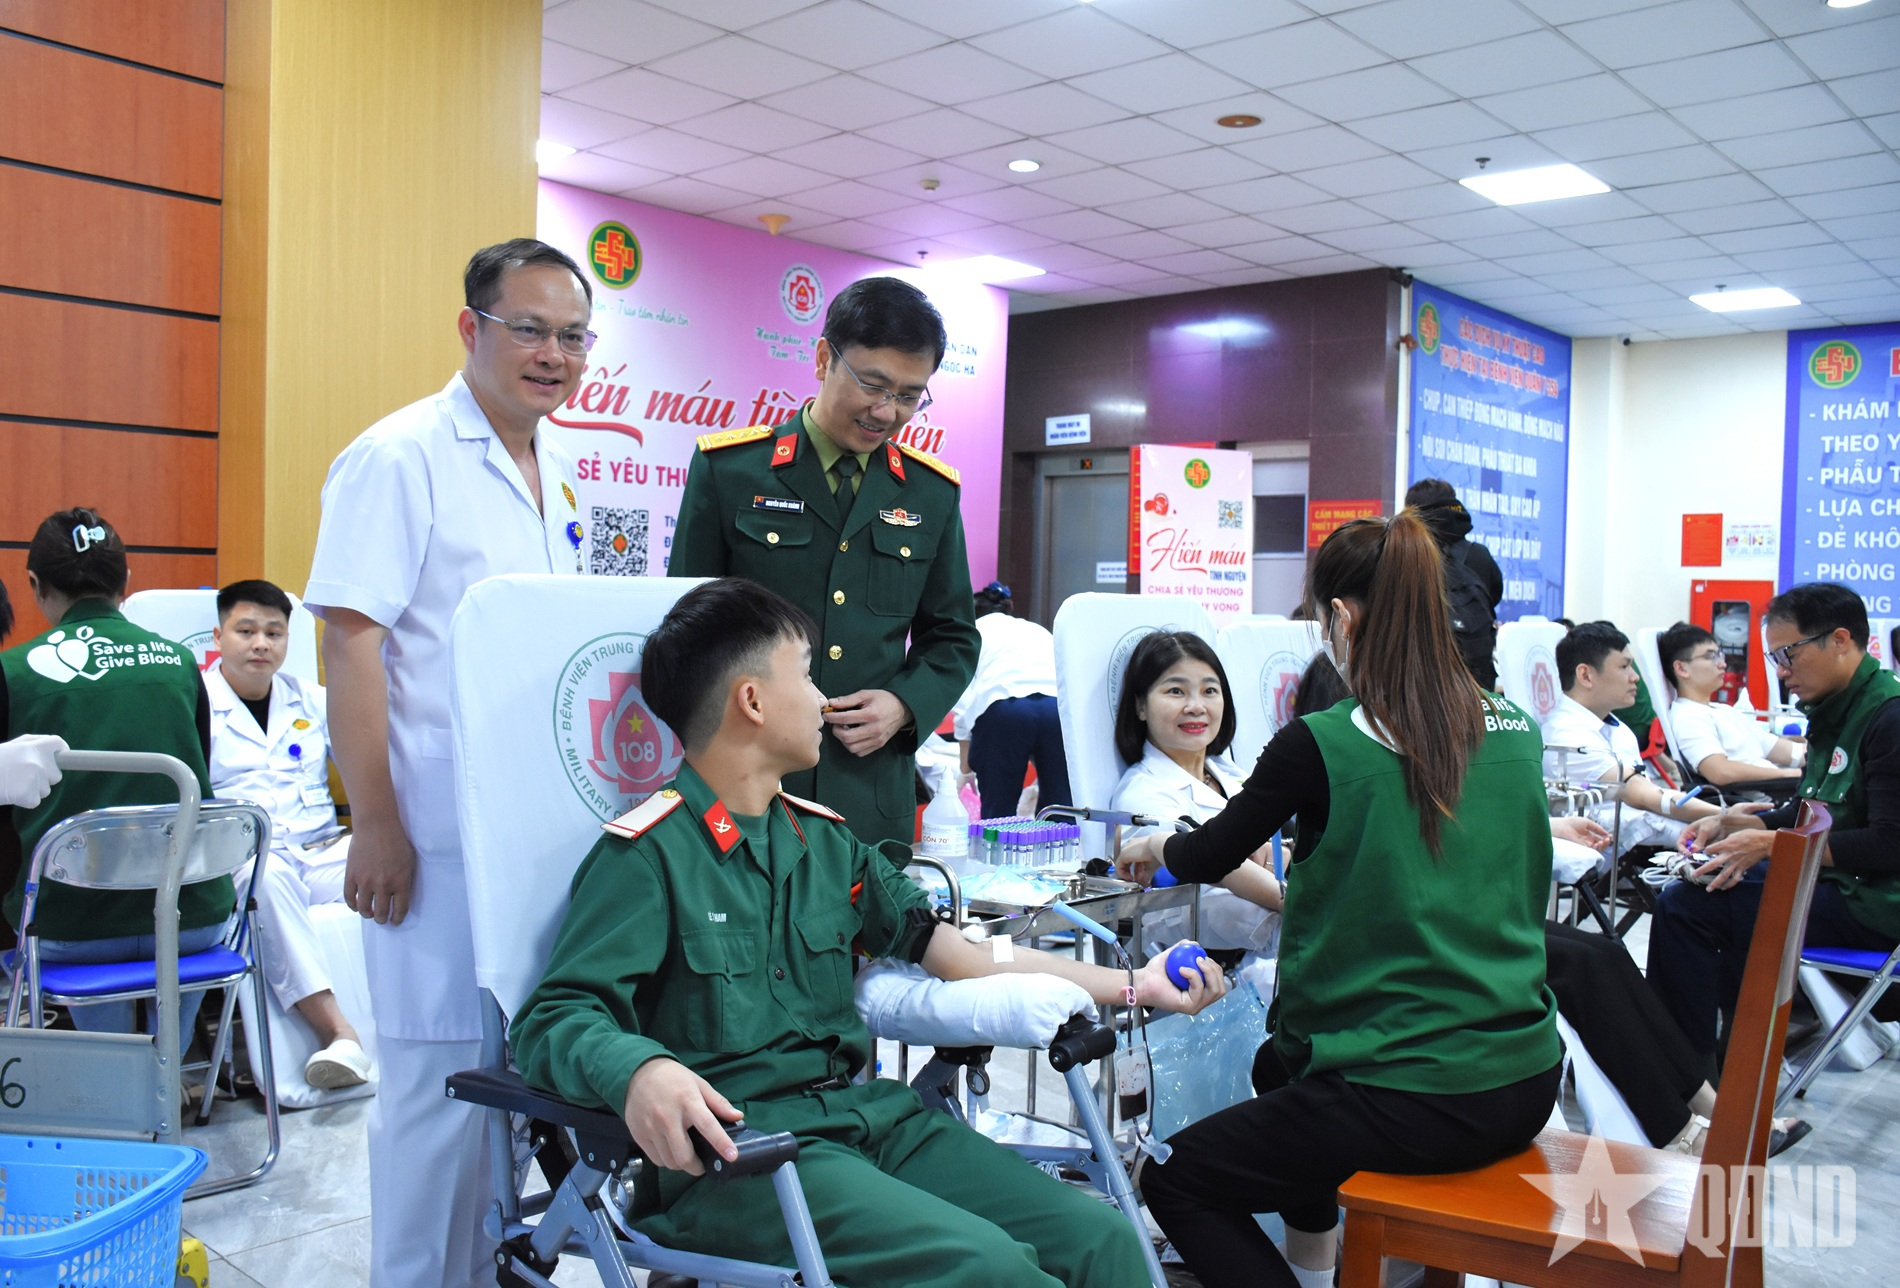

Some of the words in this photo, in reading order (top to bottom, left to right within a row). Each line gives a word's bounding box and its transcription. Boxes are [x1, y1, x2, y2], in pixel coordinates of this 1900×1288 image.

[644, 379, 736, 428] máu
[1822, 397, 1890, 421] KHÁM
[1821, 433, 1879, 453] THEO
[577, 452, 601, 480] SẺ
[610, 457, 648, 485] YÊU
[1820, 458, 1882, 485] PHẪU
[1818, 497, 1863, 522] LỰA
[1870, 498, 1900, 517] CH
[1817, 524, 1846, 548] ĐẺ
[1854, 526, 1900, 549] KHÔ
[1146, 527, 1208, 575] Hiến
[1208, 542, 1246, 565] máu
[1816, 559, 1895, 581] PHÒNG
[1147, 585, 1171, 595] CHIA
[1187, 584, 1203, 596] YÊU
[92, 643, 134, 656] Save
[138, 643, 148, 652] a
[150, 641, 174, 653] life
[591, 642, 634, 662] TRUNG
[95, 656, 135, 669] Give
[138, 652, 182, 666] Blood
[1485, 715, 1530, 732] Blood
[620, 741, 656, 763] 108
[565, 747, 612, 814] MILITARY
